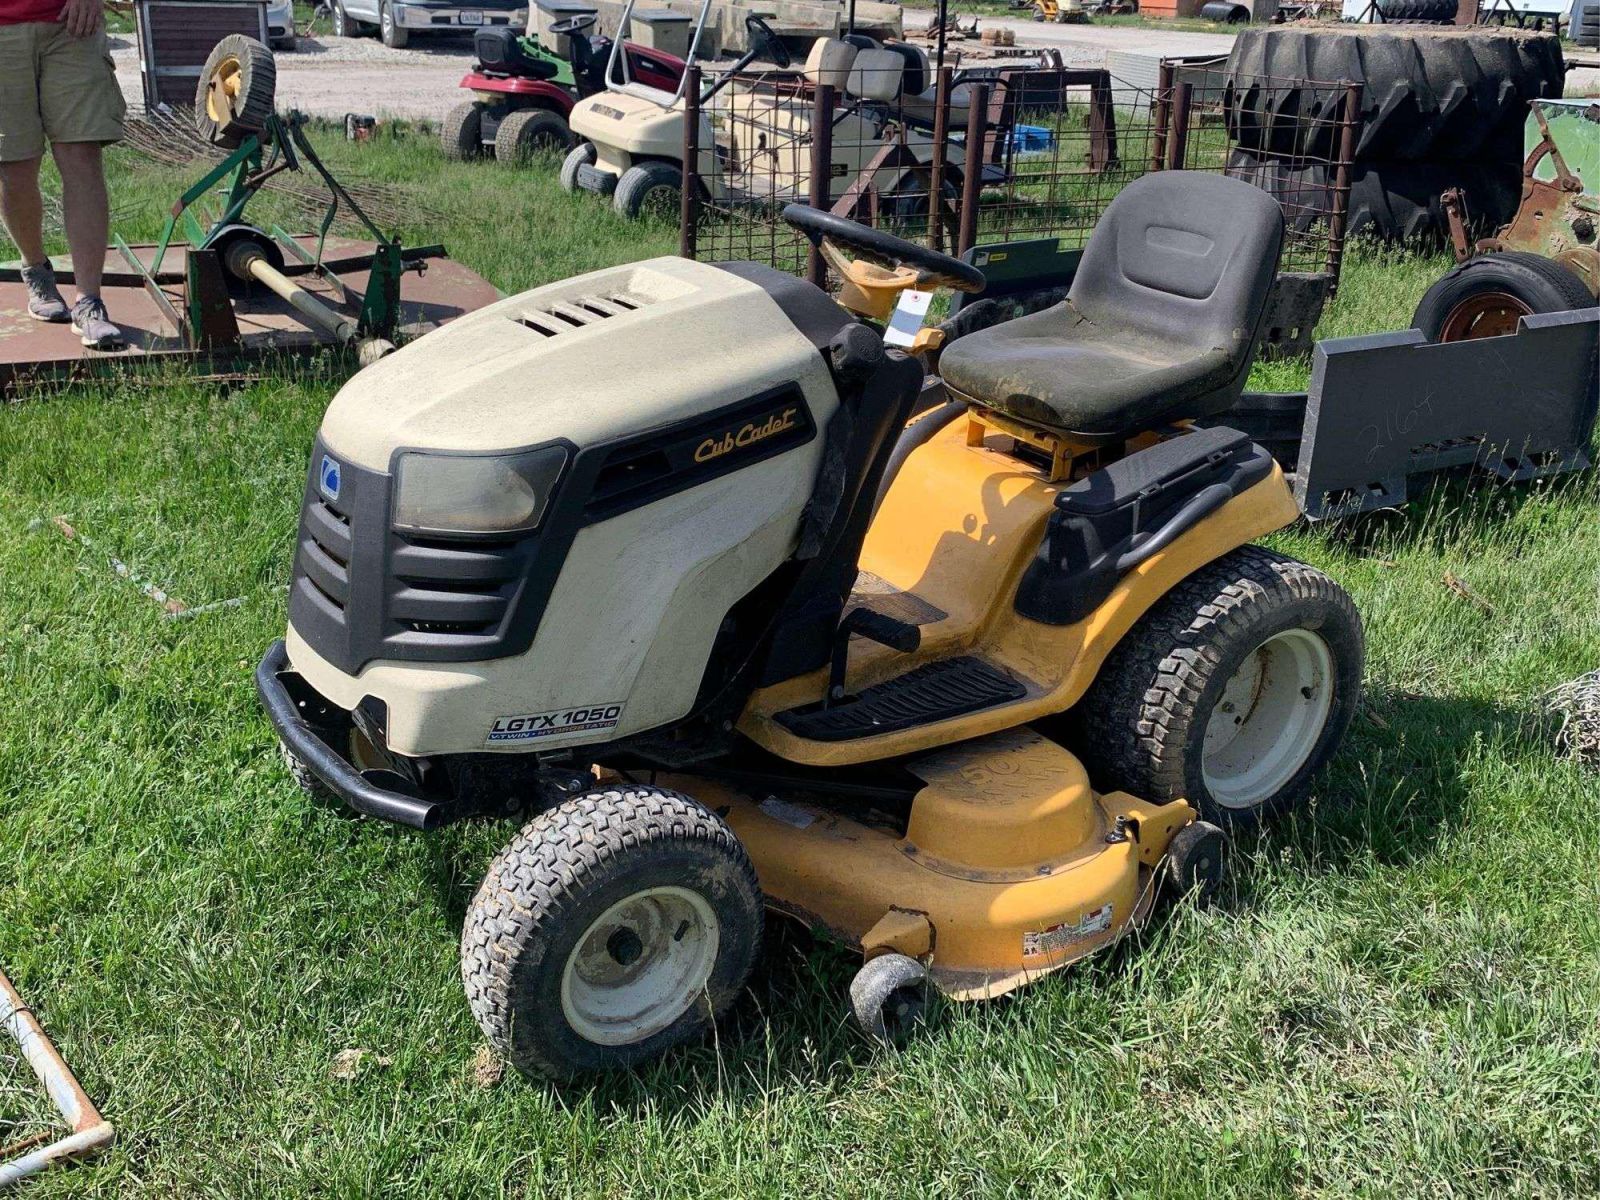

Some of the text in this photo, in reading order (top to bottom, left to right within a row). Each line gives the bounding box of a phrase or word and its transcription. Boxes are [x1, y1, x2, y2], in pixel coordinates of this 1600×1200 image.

[694, 408, 797, 462] Cub Cadet
[491, 706, 621, 733] LGTX 1050
